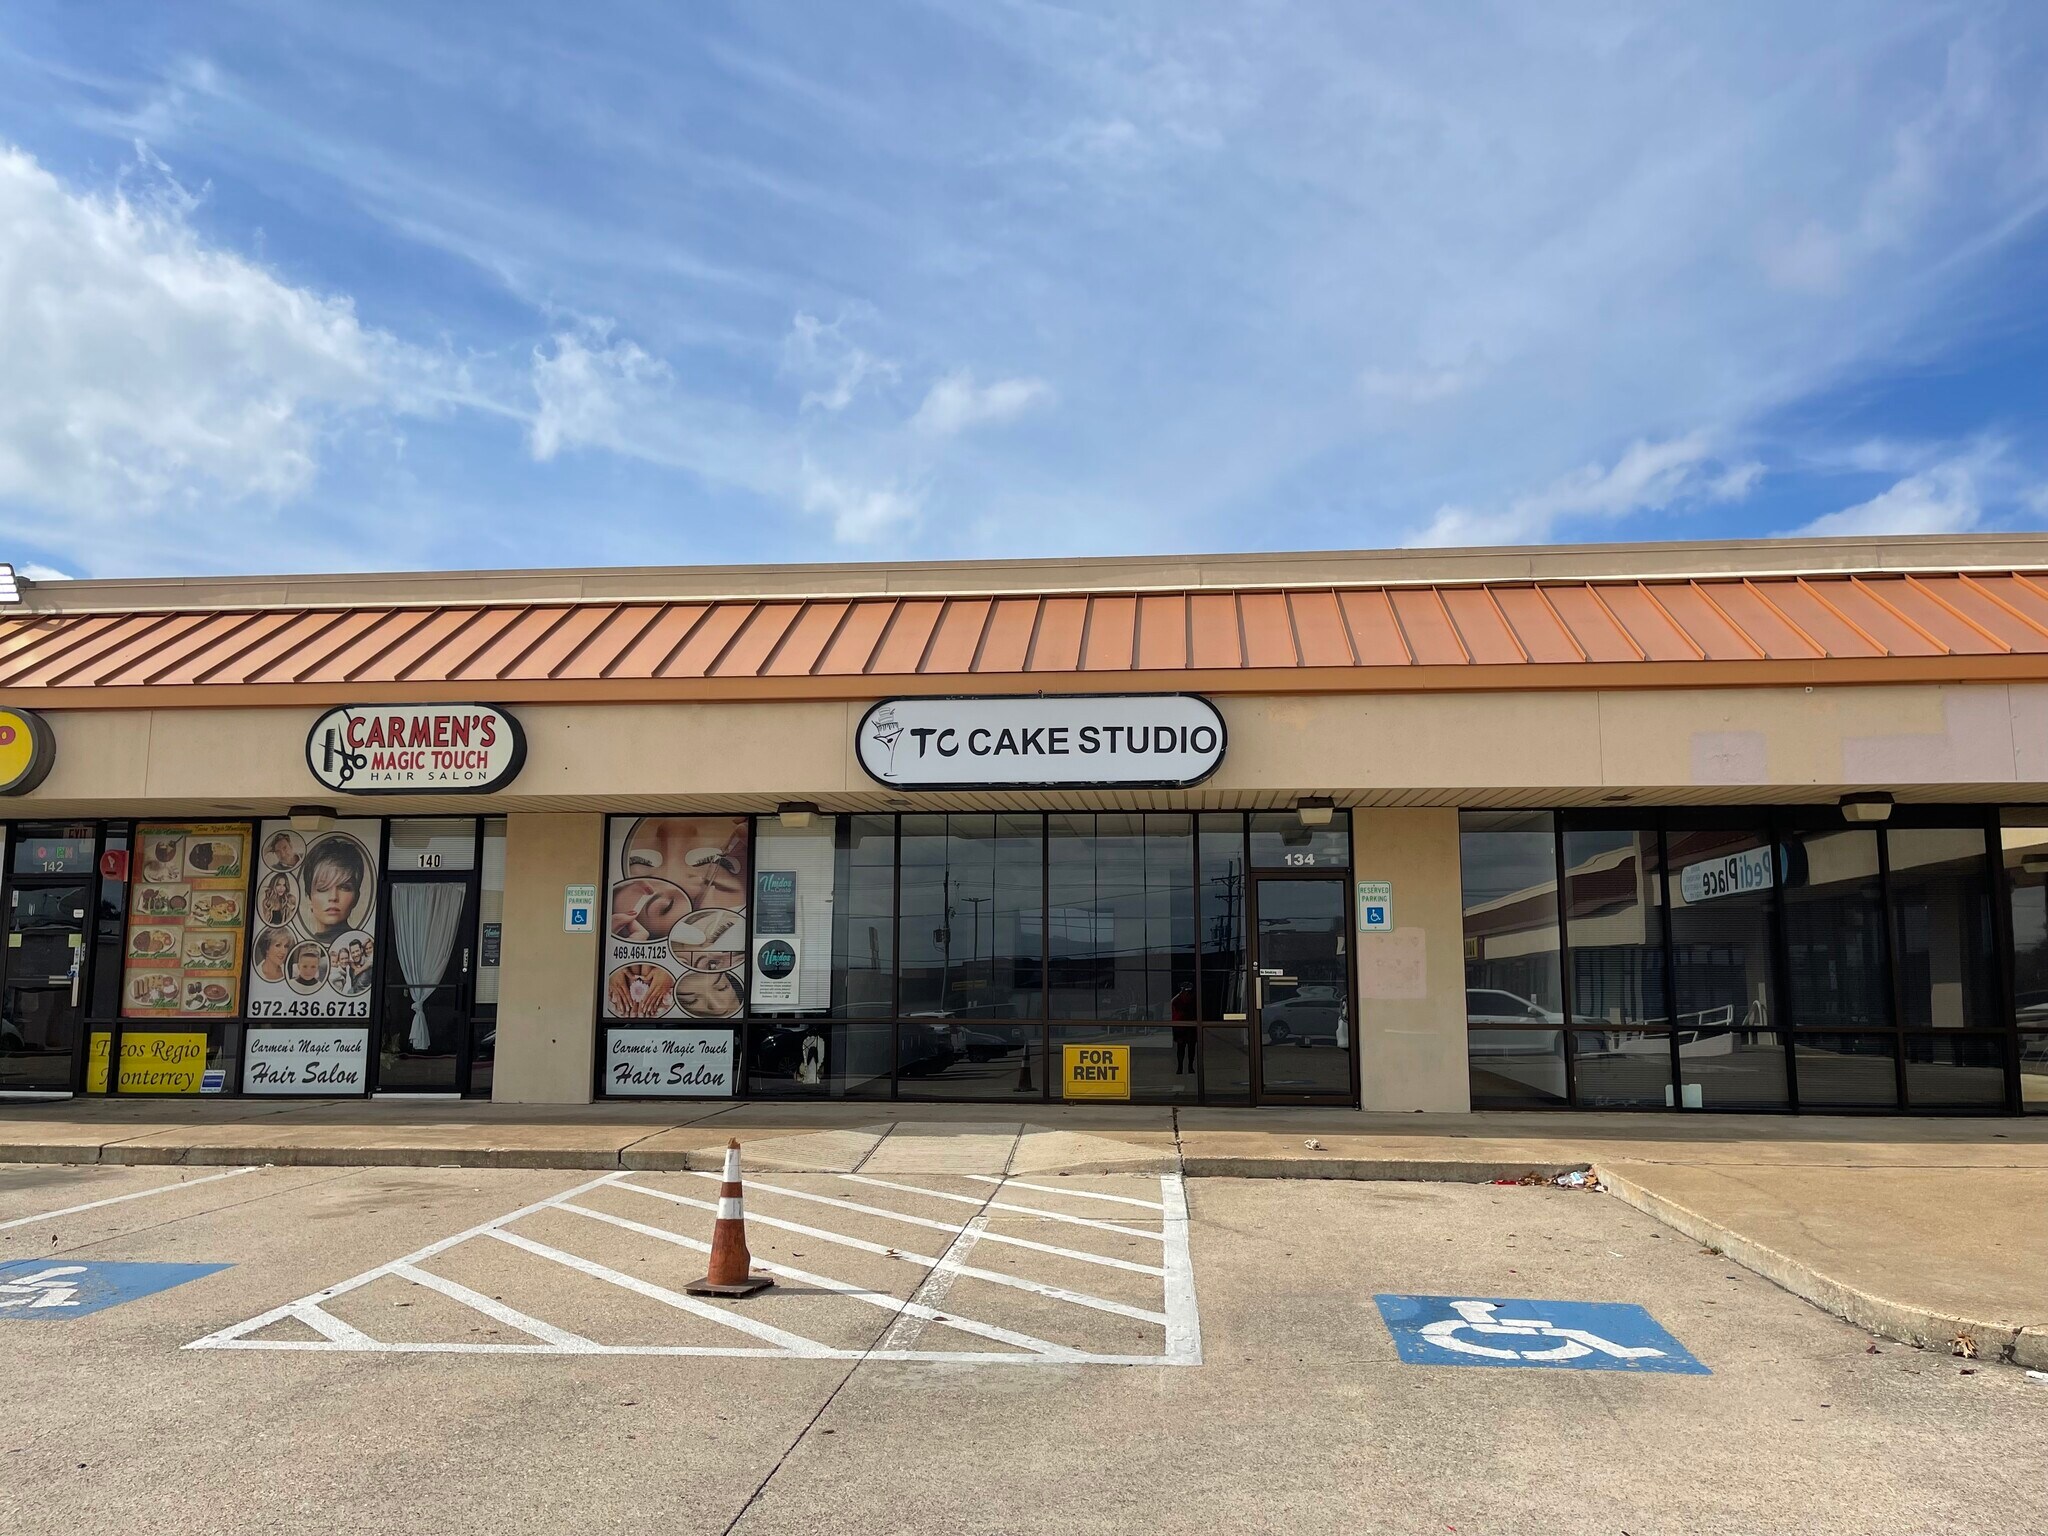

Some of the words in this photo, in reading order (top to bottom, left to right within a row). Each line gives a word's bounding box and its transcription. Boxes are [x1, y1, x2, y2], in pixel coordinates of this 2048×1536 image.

[346, 714, 496, 749] CARMEN'S
[910, 727, 960, 758] TC
[968, 727, 1070, 757] CAKE
[1078, 725, 1218, 755] STUDIO
[371, 751, 425, 770] MAGIC
[431, 750, 488, 770] TOUCH
[370, 771, 415, 781] HAIR
[428, 771, 487, 781] SALON
[42, 861, 64, 872] 142
[419, 854, 441, 868] 140
[1284, 853, 1315, 866] 134
[567, 889, 595, 897] RESERVED
[568, 897, 592, 905] PARKING
[613, 946, 667, 959] 469.464.7125
[251, 1000, 368, 1017] 972.436.6713
[96, 1040, 146, 1058] Tcos
[150, 1039, 200, 1065] Regio
[250, 1039, 295, 1053] Carmen's
[298, 1039, 330, 1056] Magic
[334, 1039, 362, 1053] Touch
[612, 1039, 658, 1054] Carmen's
[662, 1040, 695, 1057] Magic
[698, 1040, 728, 1054] Touch
[1079, 1050, 1113, 1065] FOR
[250, 1062, 297, 1084] Hair
[301, 1061, 359, 1084] Salon
[613, 1062, 662, 1085] Hair
[667, 1062, 726, 1086] Salon
[1073, 1066, 1119, 1081] RENT
